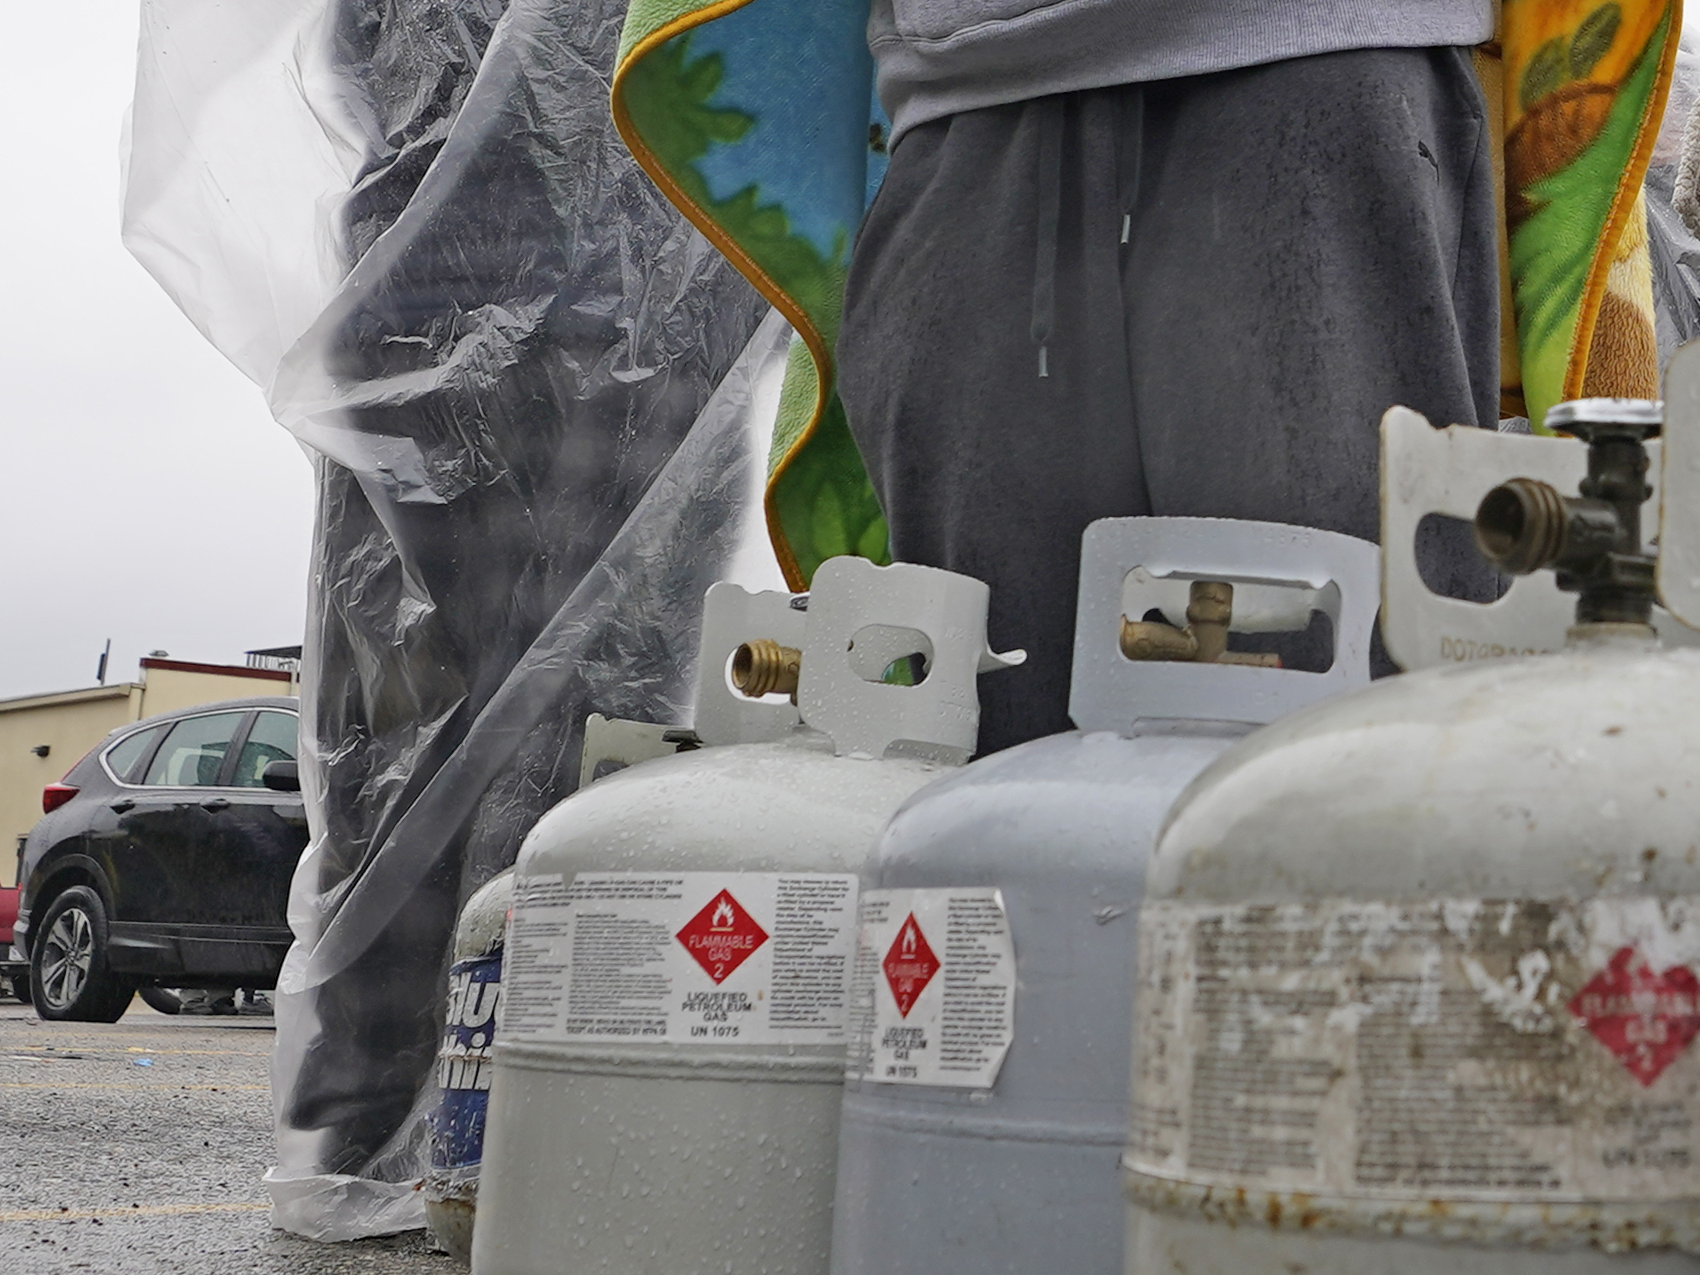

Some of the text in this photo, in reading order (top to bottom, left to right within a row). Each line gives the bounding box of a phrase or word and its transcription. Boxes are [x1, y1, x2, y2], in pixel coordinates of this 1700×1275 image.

[689, 935, 754, 948] FLAMMABLE
[708, 948, 732, 961] GAS
[714, 963, 724, 978] 2
[687, 991, 748, 1002] LIQUEFIED
[682, 1001, 753, 1012] PETROLEUM
[703, 1011, 728, 1022] GAS
[691, 1026, 740, 1037] UN 1075
